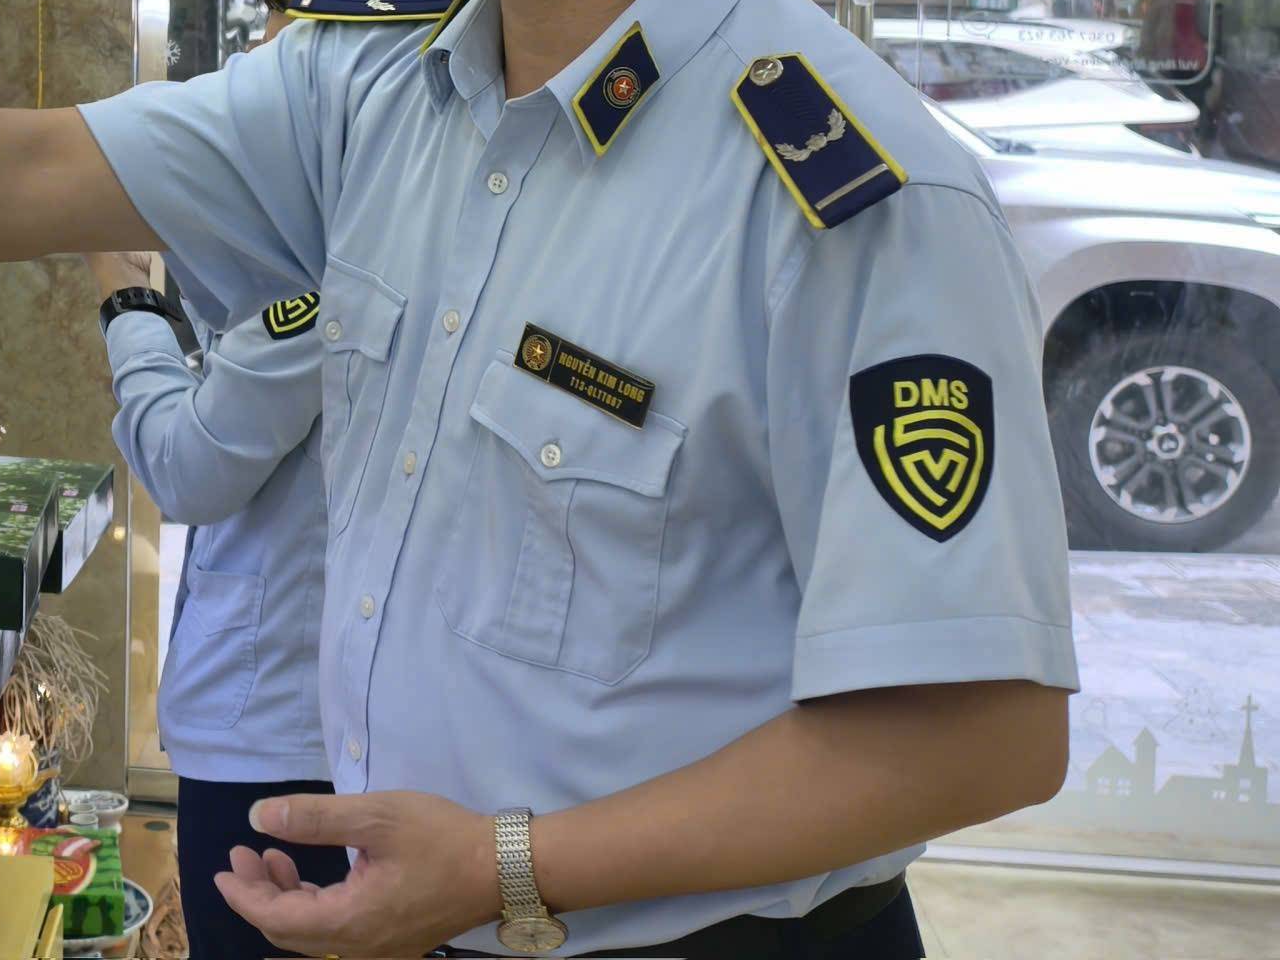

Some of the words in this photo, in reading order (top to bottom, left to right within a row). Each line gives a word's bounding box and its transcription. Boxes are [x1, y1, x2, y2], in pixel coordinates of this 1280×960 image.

[597, 370, 618, 389] KIM
[618, 380, 646, 403] LONG
[894, 378, 969, 410] DMS
